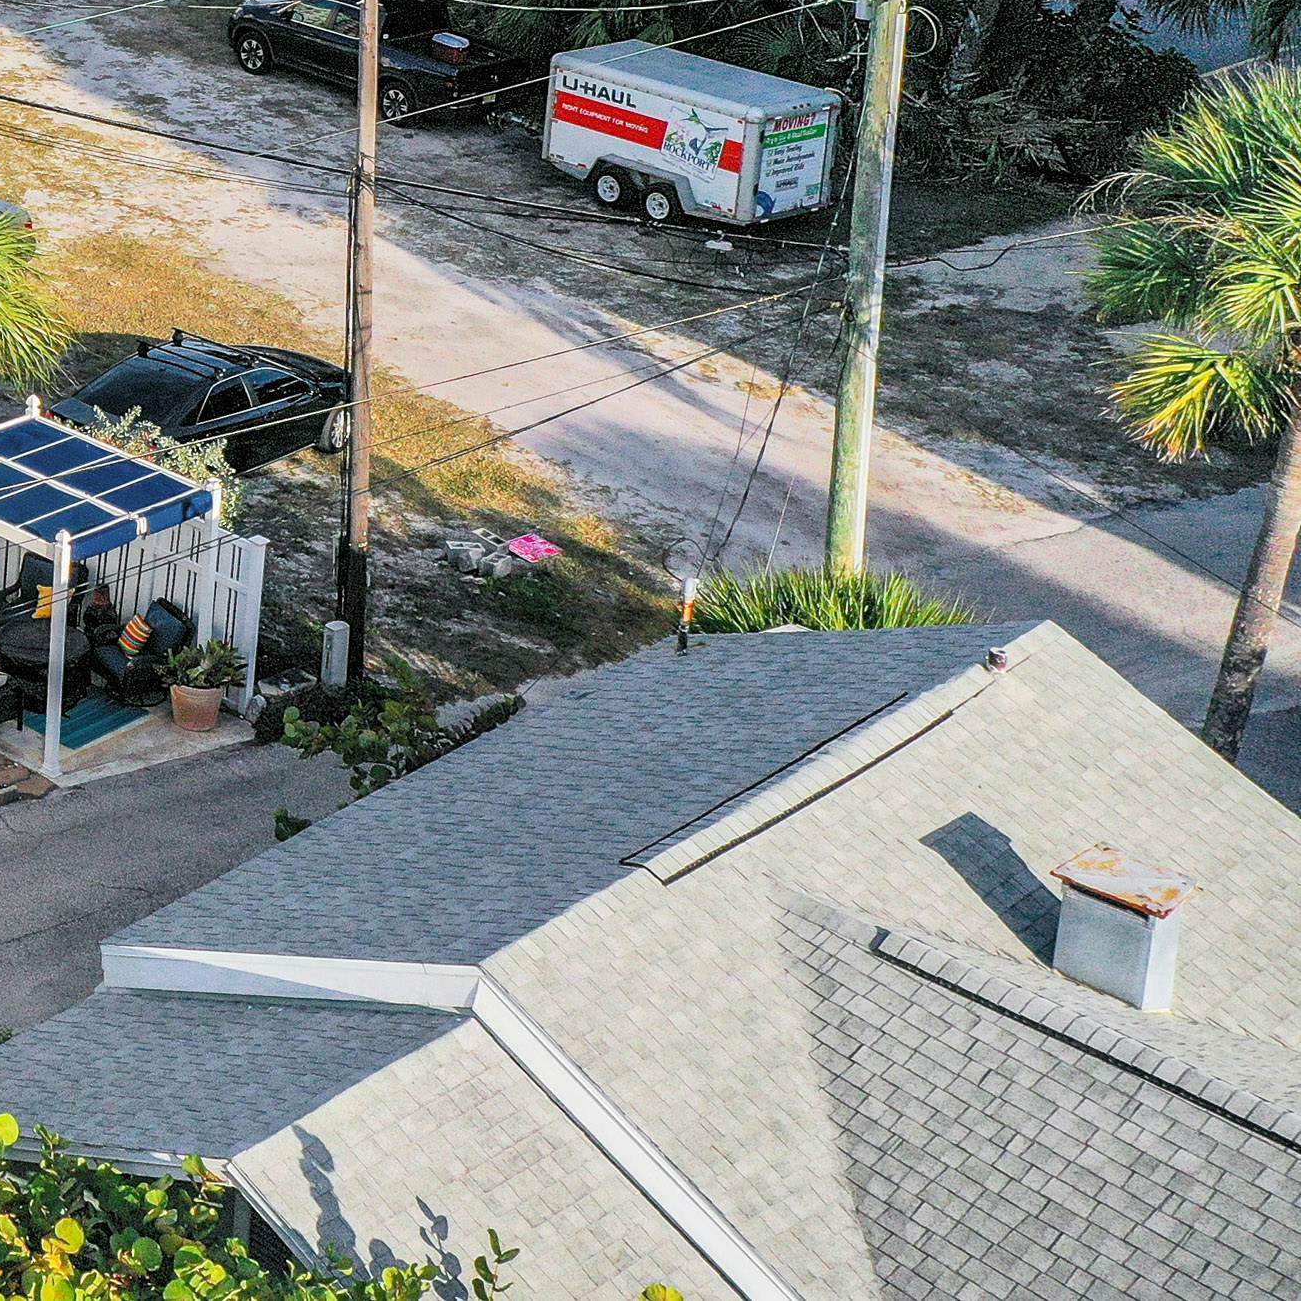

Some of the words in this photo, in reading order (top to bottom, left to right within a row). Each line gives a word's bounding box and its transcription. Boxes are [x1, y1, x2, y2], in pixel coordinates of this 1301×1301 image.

[562, 75, 637, 109] U-HAUL
[579, 107, 611, 123] EQUIPMENT
[663, 140, 711, 171] ROCKPORT
